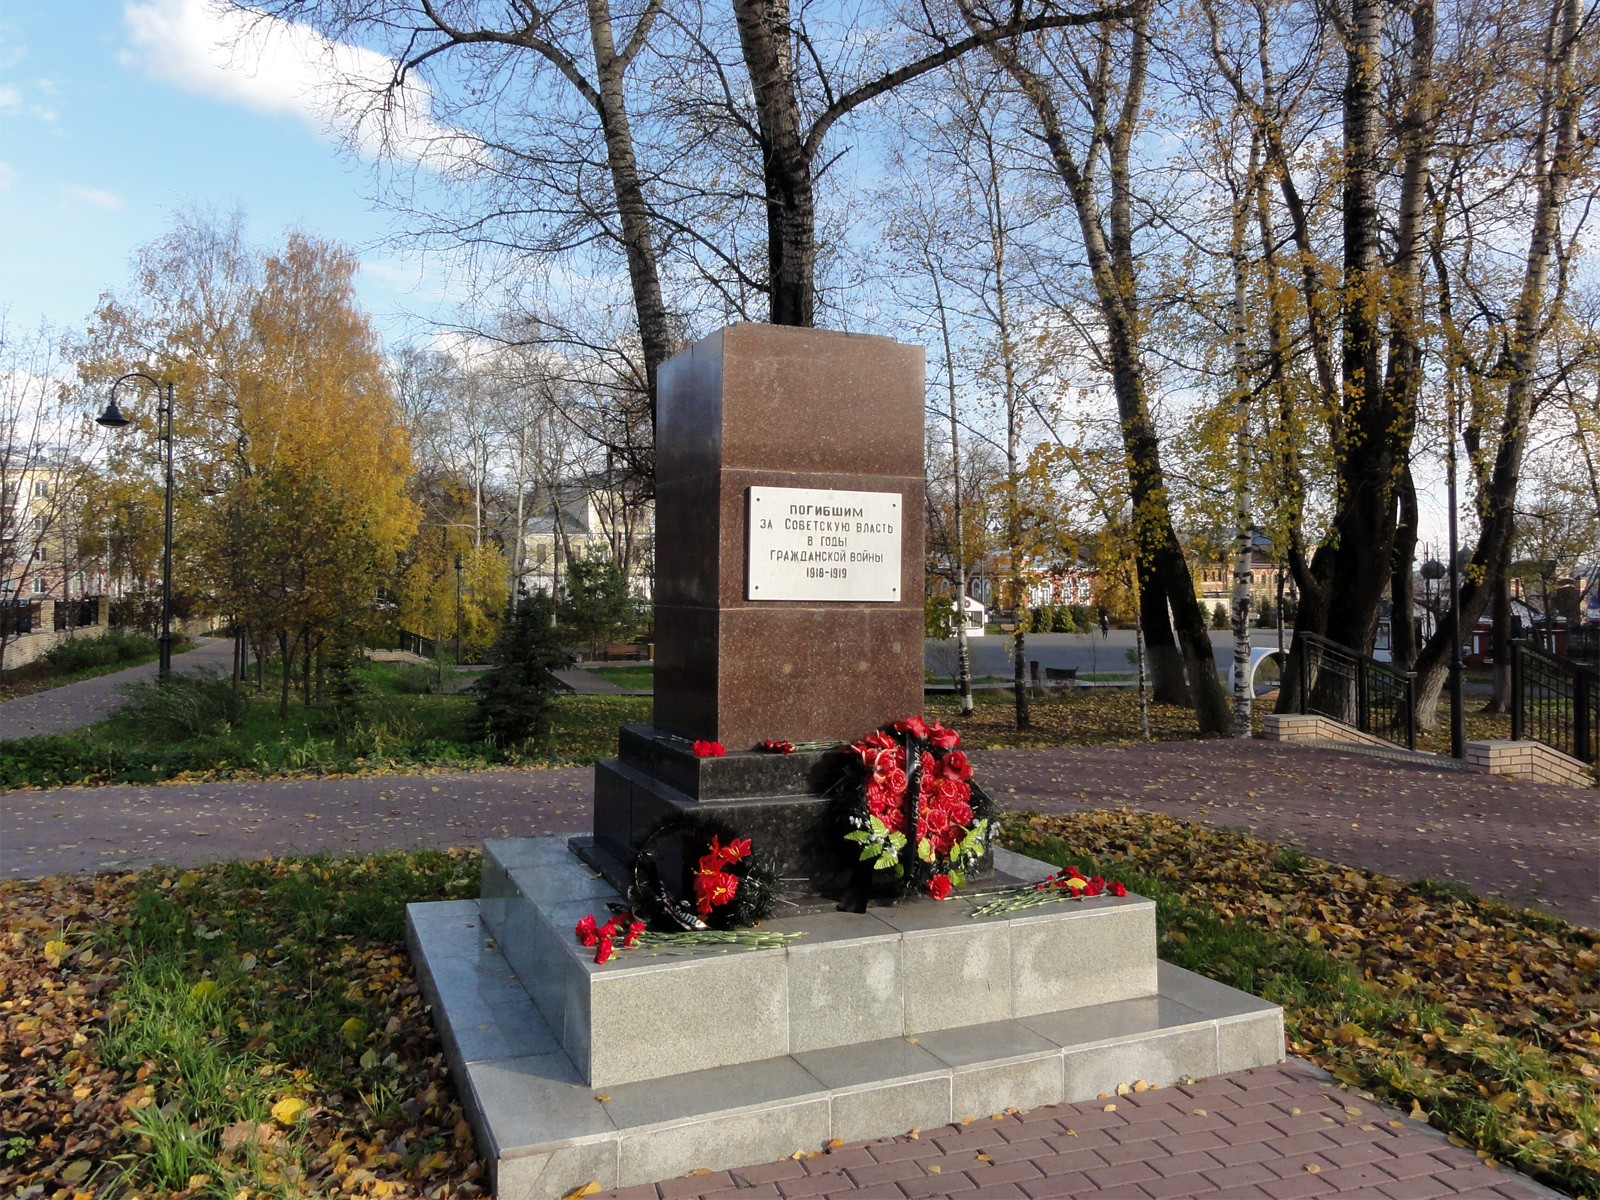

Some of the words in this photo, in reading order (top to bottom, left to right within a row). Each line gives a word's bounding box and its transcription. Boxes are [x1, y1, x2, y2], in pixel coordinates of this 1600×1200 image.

[790, 505, 863, 517] ПОГИБШИМ
[760, 519, 773, 530] ЗА
[785, 518, 850, 532] СОВЕТСКУЮ
[856, 523, 893, 534] ВЛАСТЬ
[807, 536, 813, 547] В
[820, 536, 847, 547] ГОДЫ
[770, 550, 846, 562] ГРАЖДАНСКОЙ
[850, 550, 883, 563] ВОЙНЫ
[806, 567, 847, 578] 1918-1919
